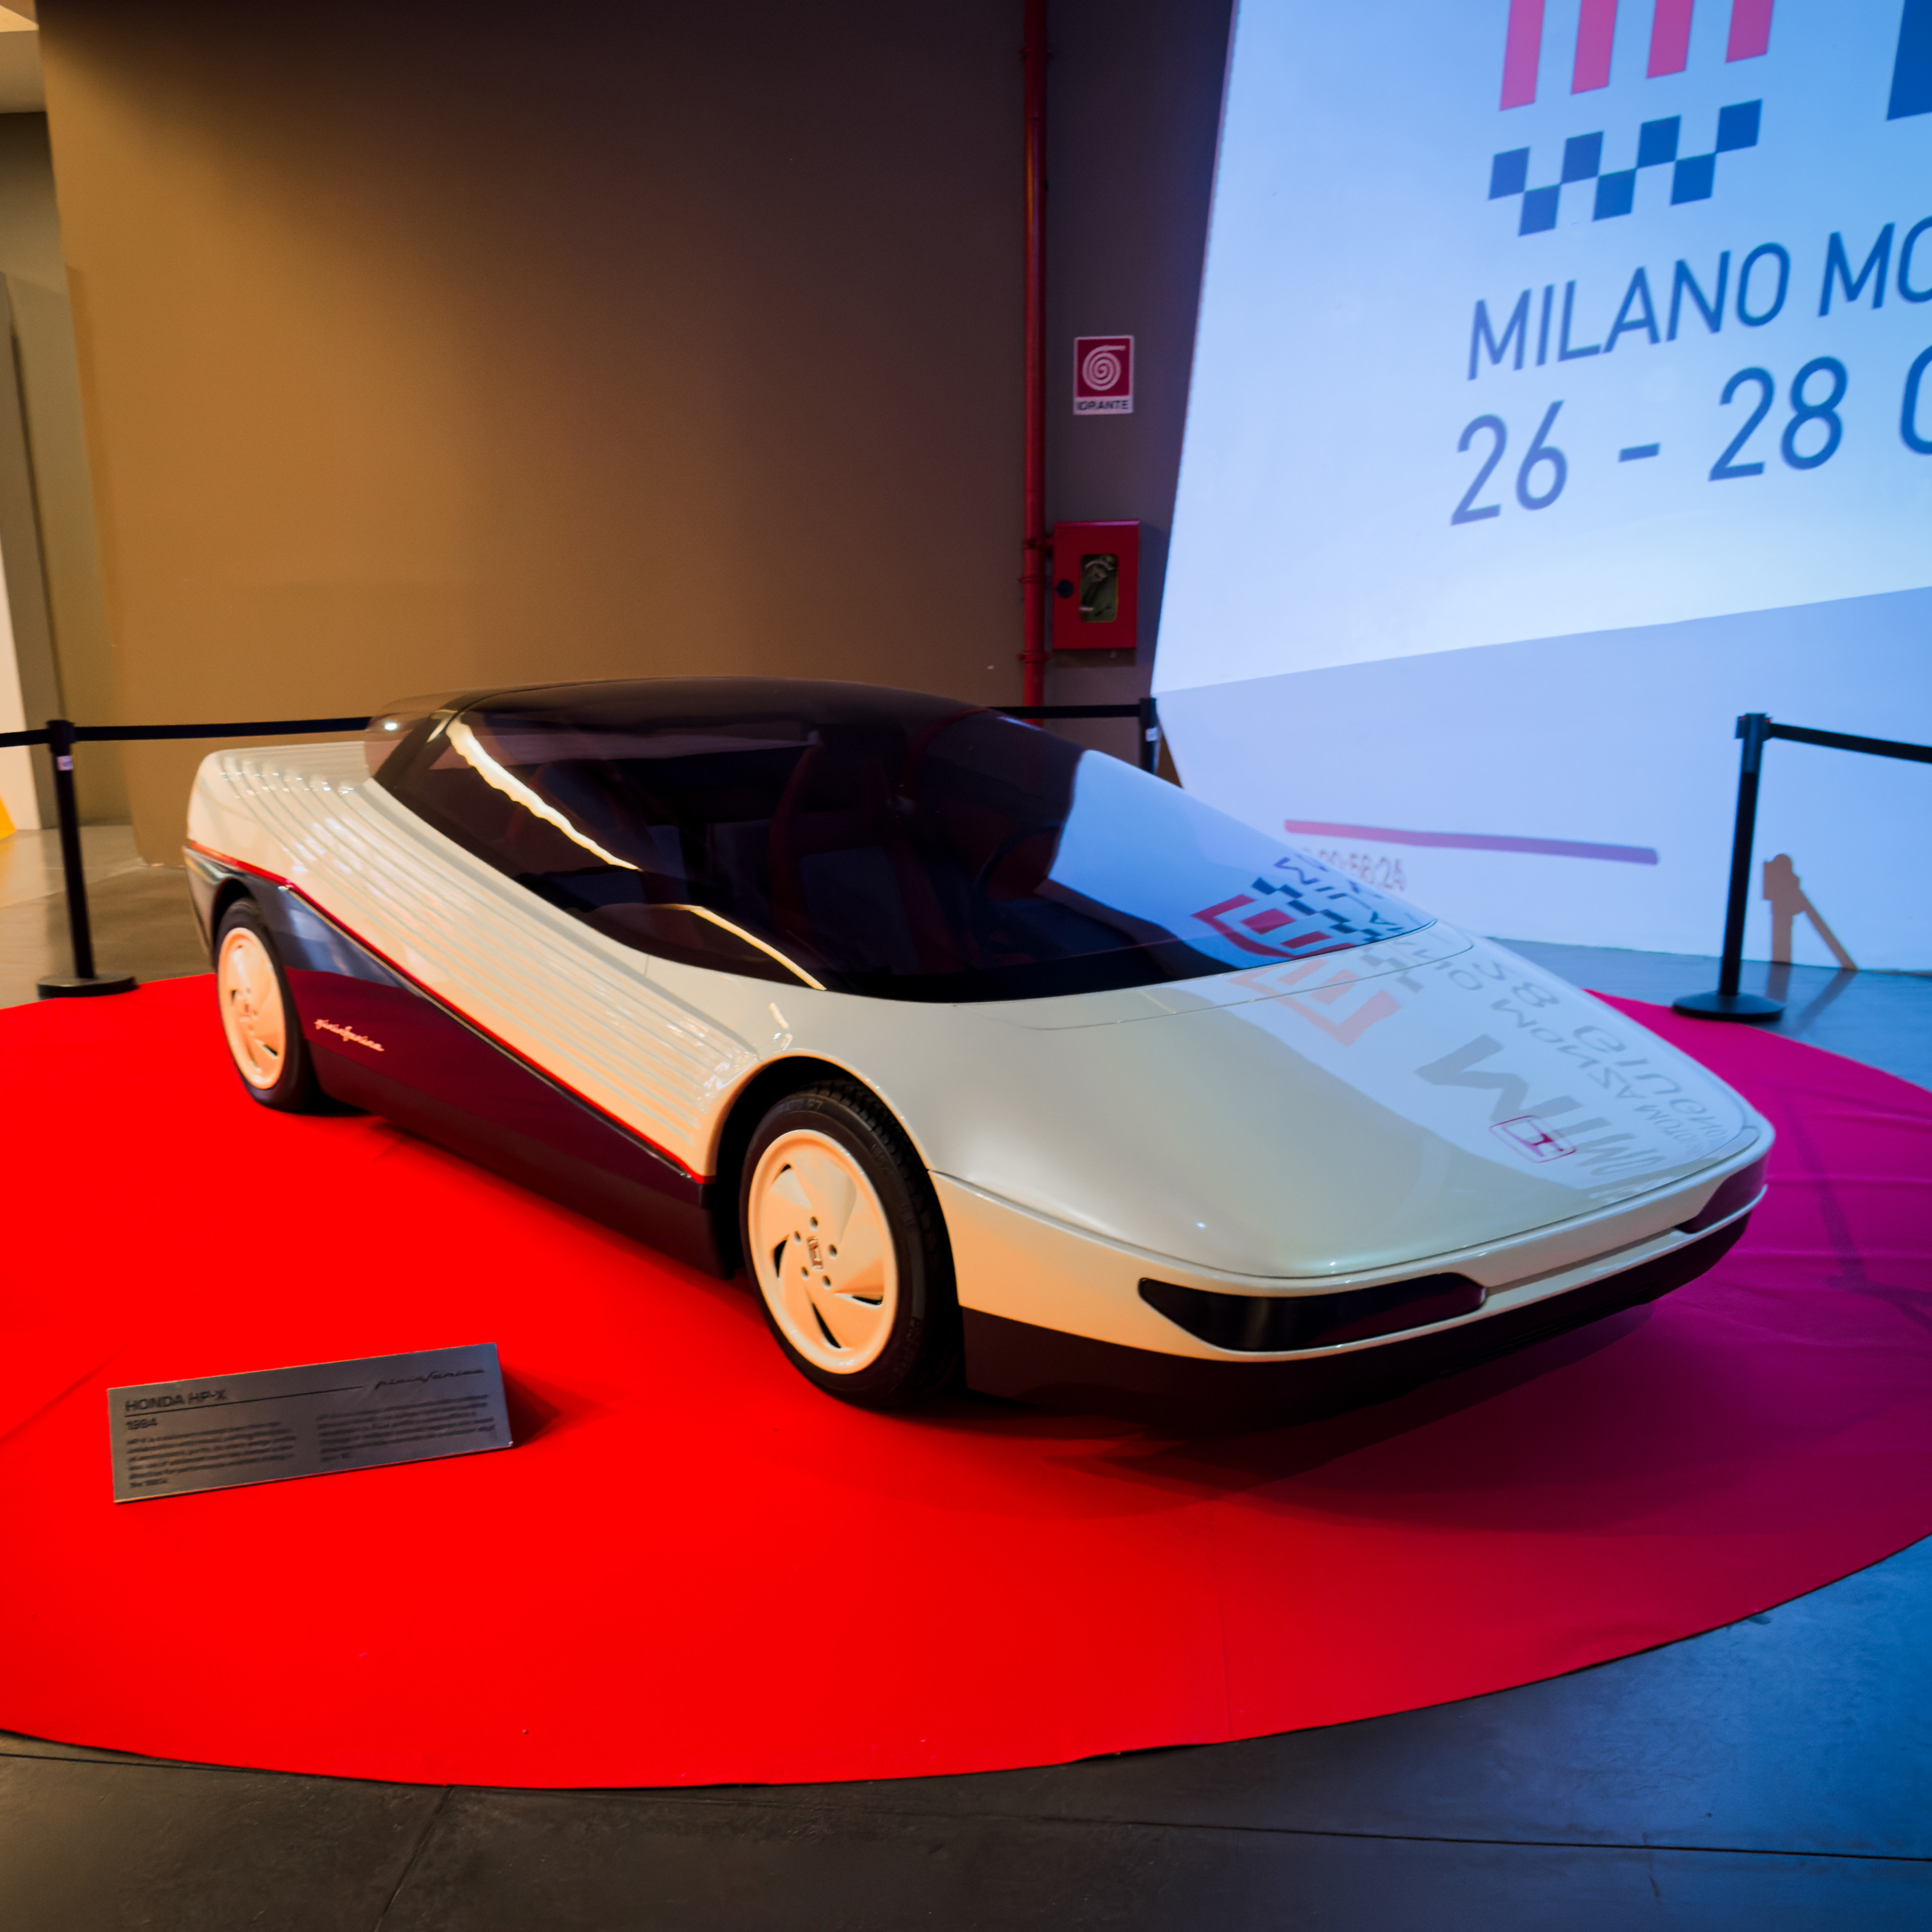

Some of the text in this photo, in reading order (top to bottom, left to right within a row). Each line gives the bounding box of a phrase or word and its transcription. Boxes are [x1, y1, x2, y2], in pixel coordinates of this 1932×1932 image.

[1468, 242, 1791, 380] MILANO
[1076, 400, 1129, 410] IDRANTE
[1451, 399, 1567, 526] 26
[1709, 356, 1848, 481] 28
[125, 1389, 227, 1412] HONDA HP-X
